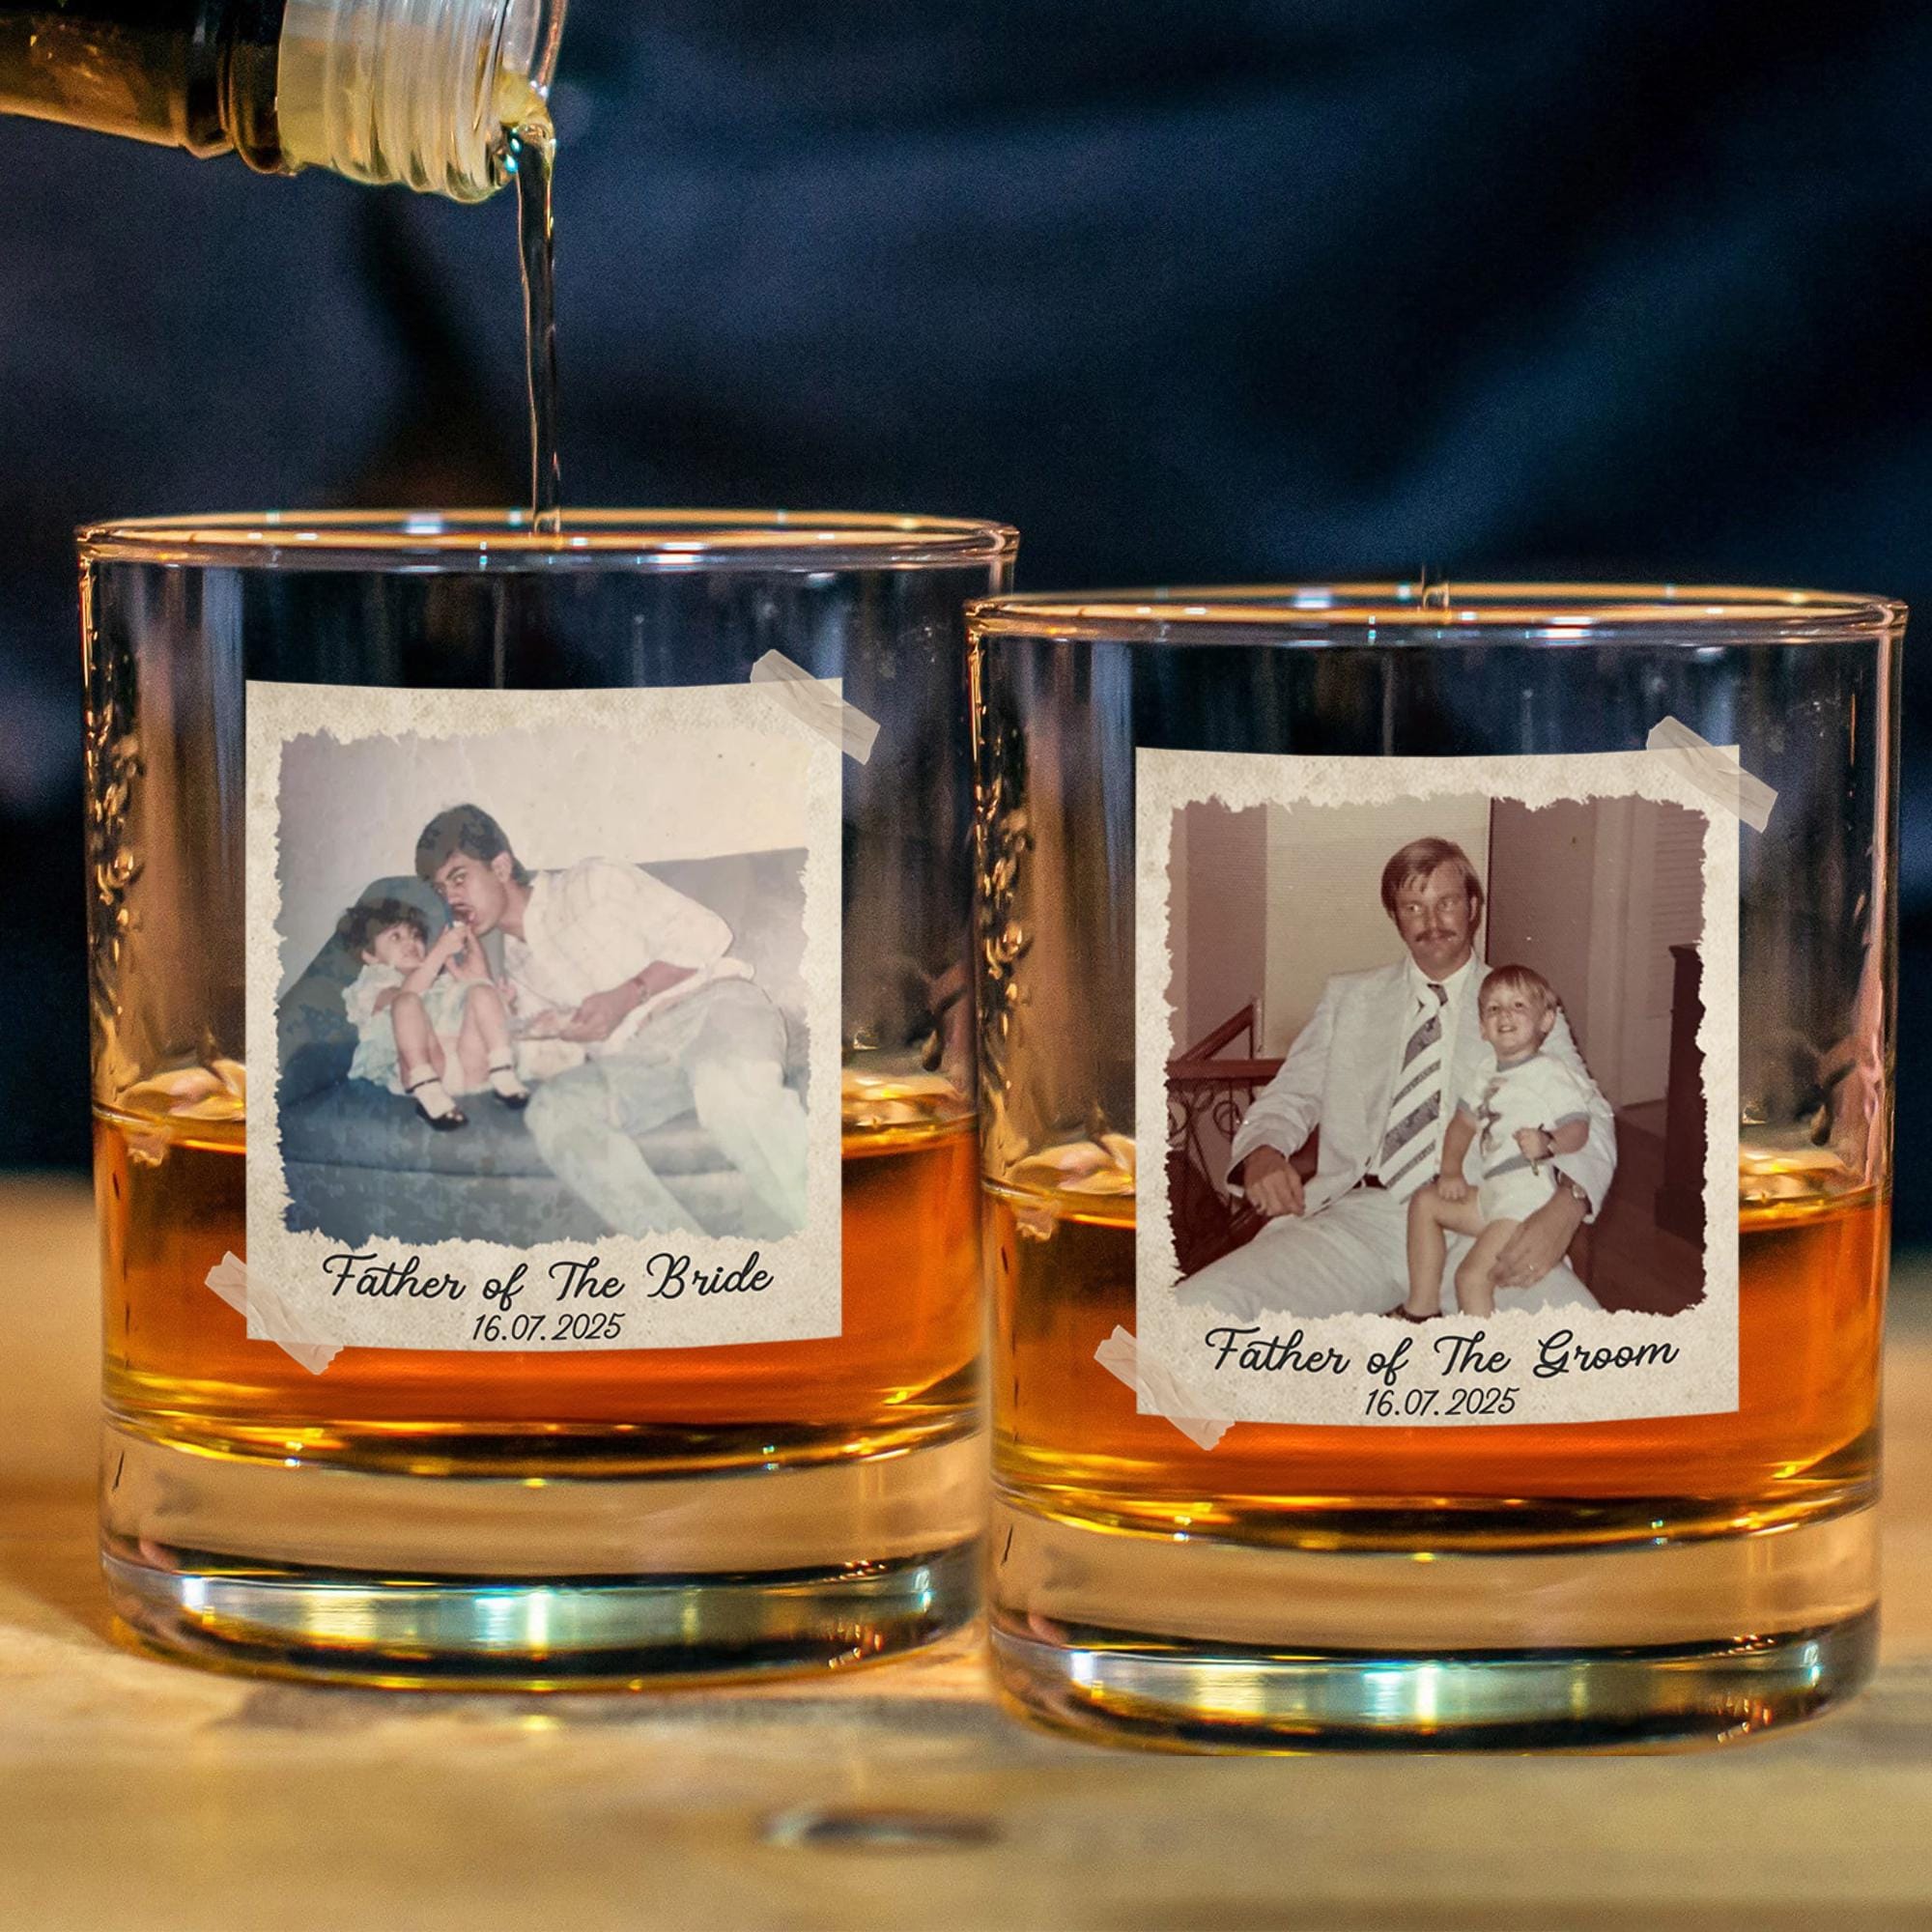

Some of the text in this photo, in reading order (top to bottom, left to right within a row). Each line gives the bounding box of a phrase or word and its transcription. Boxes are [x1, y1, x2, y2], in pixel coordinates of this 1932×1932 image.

[322, 1250, 775, 1312] Father of The Bride
[472, 1312, 626, 1343] 16.07.2025
[1205, 1326, 1680, 1387] Father of The Groom
[1365, 1387, 1520, 1417] 16.07.2025
